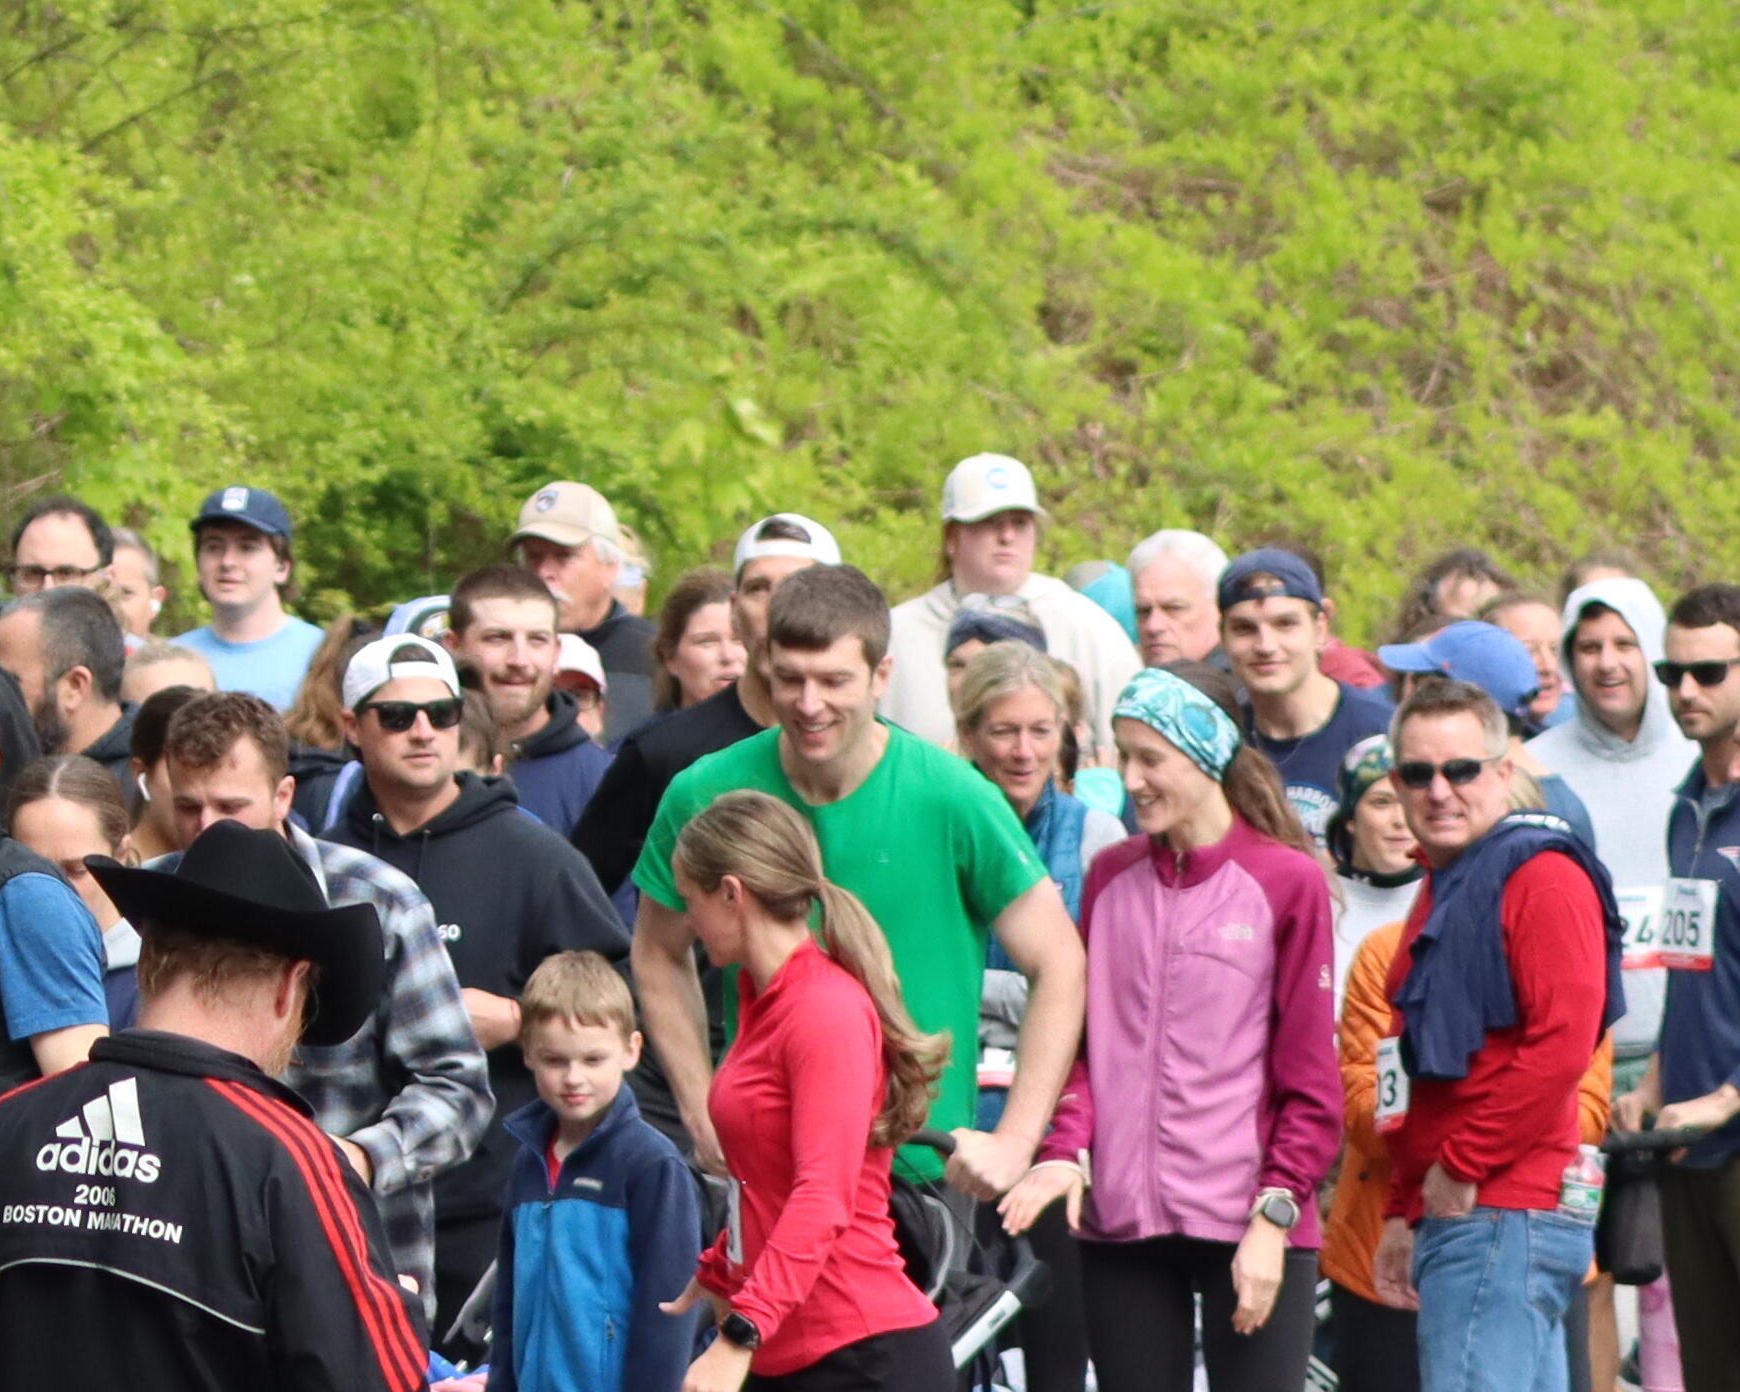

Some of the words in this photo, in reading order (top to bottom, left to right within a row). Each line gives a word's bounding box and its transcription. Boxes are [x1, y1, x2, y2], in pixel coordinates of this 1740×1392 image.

[1661, 912, 1701, 948] 205
[35, 1136, 162, 1183] adidas
[2, 1204, 82, 1228] BOSTON
